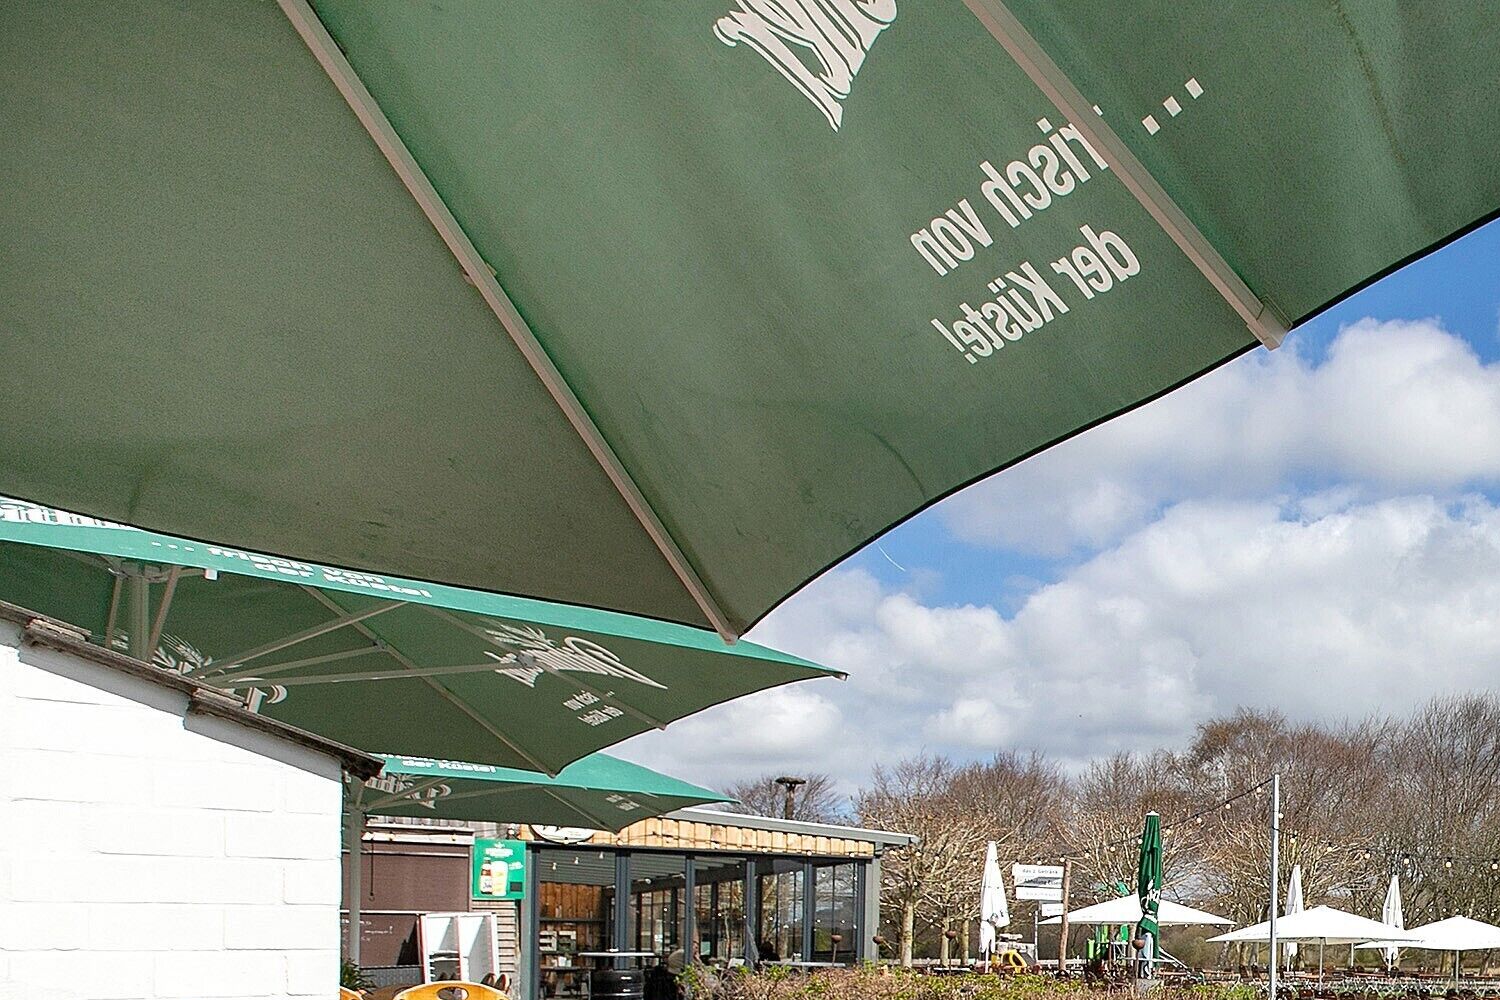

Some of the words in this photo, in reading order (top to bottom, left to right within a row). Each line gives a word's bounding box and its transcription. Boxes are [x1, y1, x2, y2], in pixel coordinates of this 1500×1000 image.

[207, 547, 314, 572] frisch
[321, 566, 386, 585] von
[254, 562, 316, 578] der
